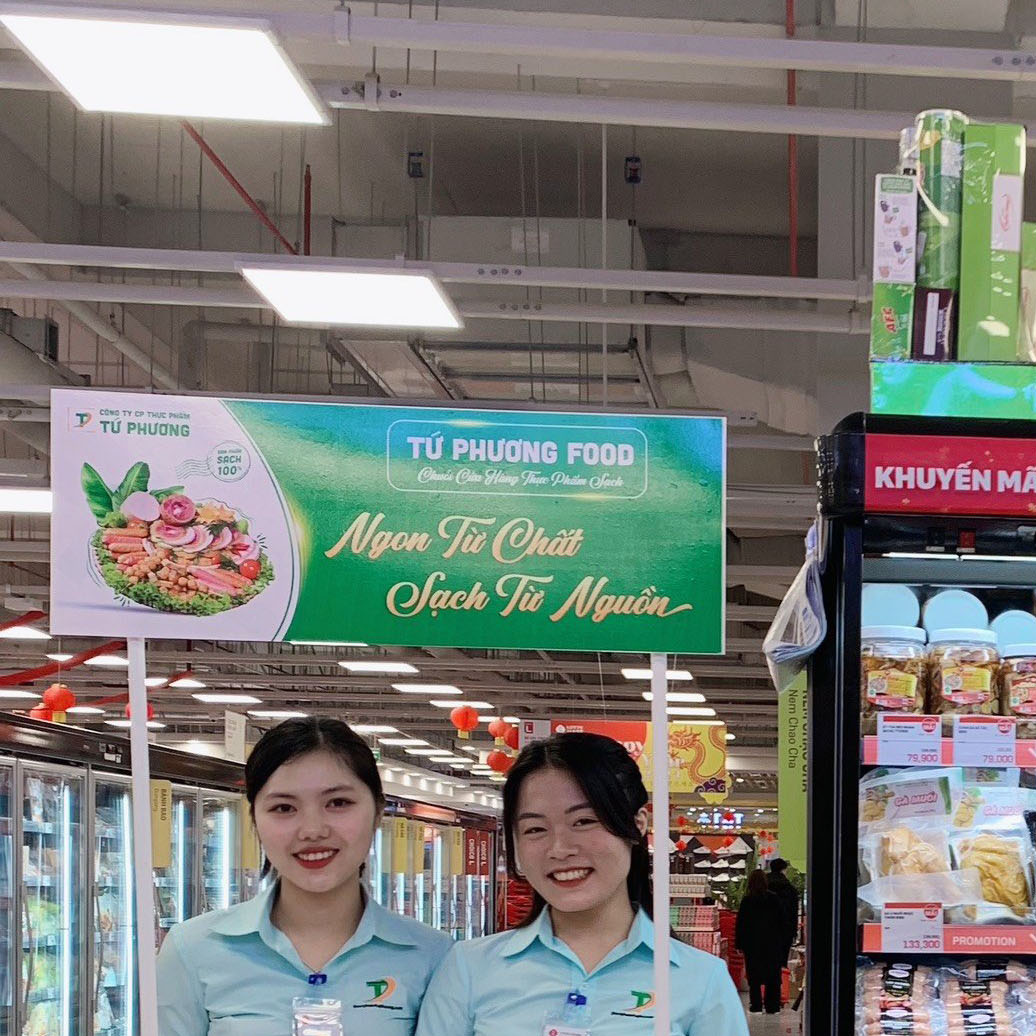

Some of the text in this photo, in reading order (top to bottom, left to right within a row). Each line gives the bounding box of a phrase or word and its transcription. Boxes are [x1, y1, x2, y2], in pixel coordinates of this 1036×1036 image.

[100, 419, 190, 437] TỨ PHƯƠNG
[407, 431, 634, 466] TỨ PHƯƠNG FOOD
[875, 461, 992, 492] KHUYẾN
[324, 511, 584, 563] Ngon Từ Chất
[385, 571, 693, 623] Sạch Từ Nguồn
[788, 689, 798, 769] Nem Chao Cha
[952, 936, 1016, 947] PROMOTION
